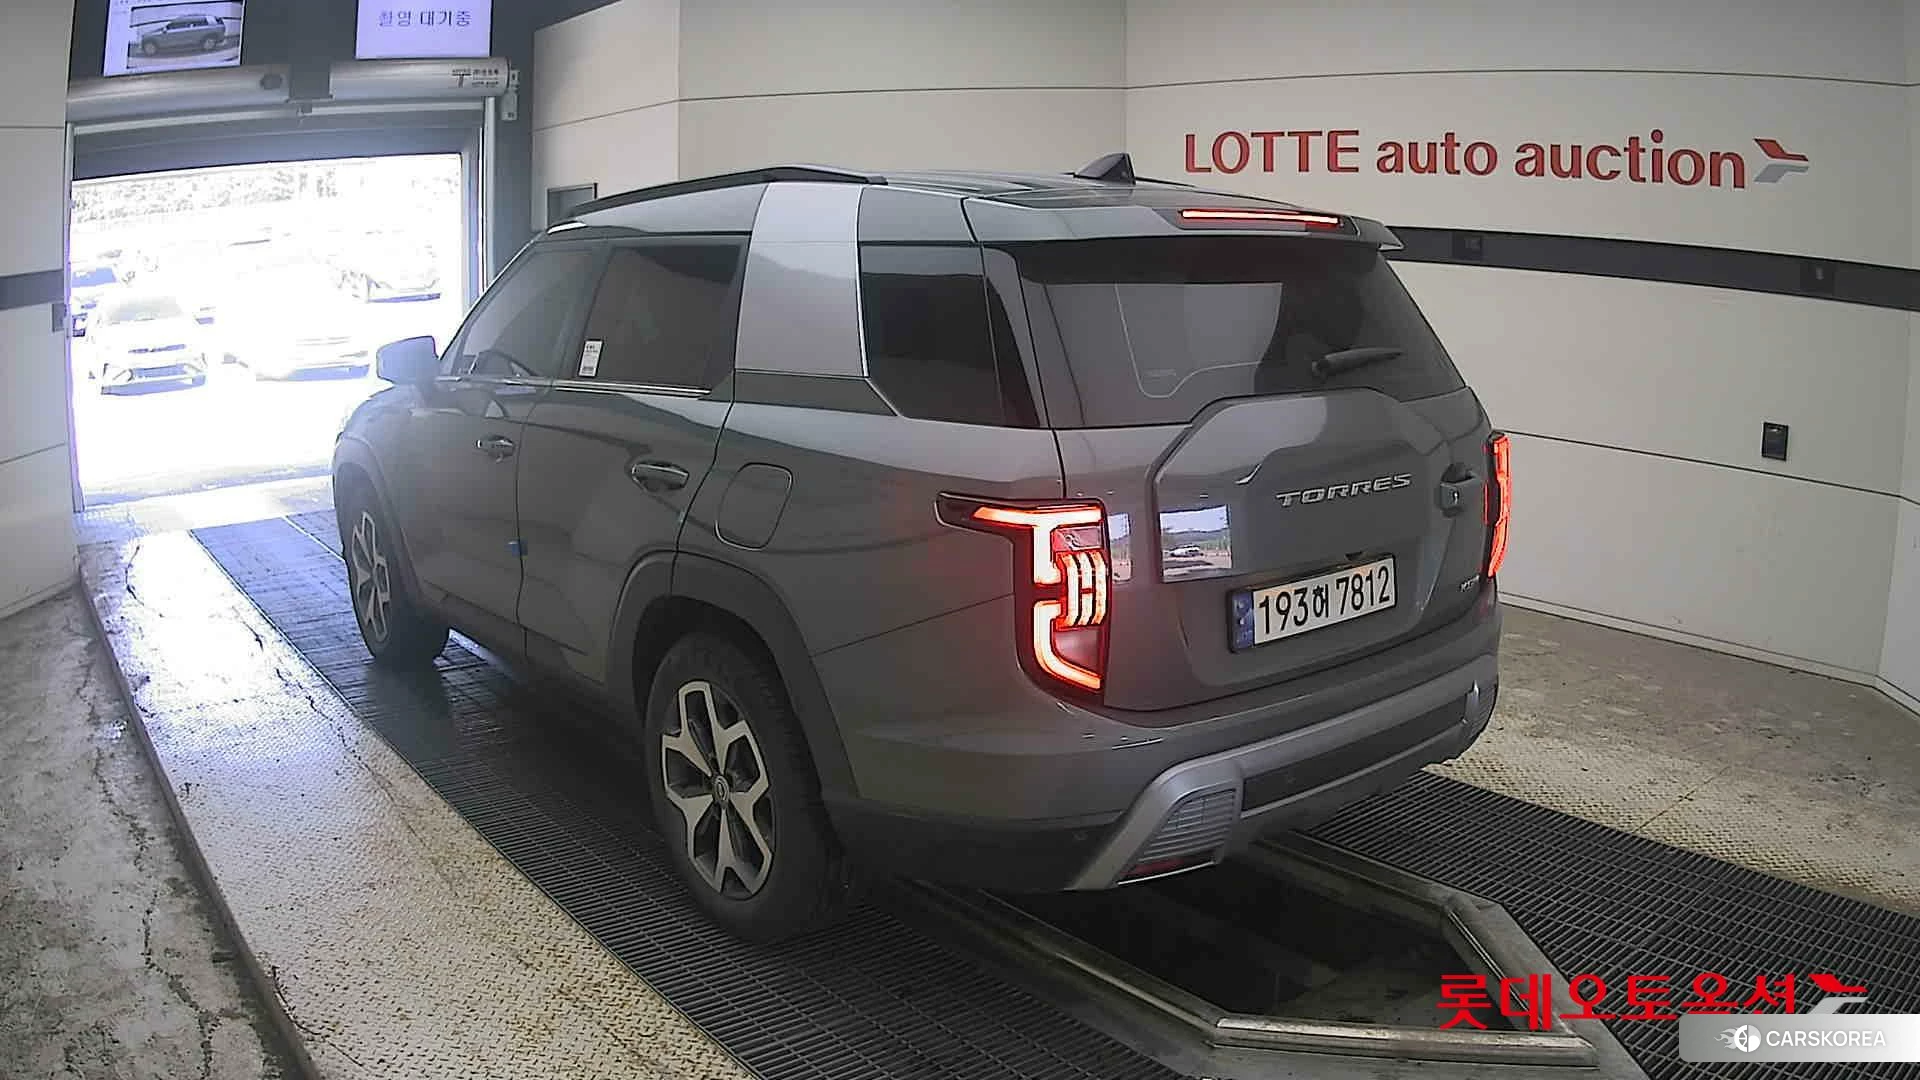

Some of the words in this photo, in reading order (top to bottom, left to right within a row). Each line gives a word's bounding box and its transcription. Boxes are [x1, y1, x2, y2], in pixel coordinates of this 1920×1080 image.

[420, 10, 472, 27] 대기중
[1185, 130, 1360, 174] LOTTE
[1377, 132, 1498, 177] auto
[1514, 130, 1745, 188] auction
[1276, 473, 1412, 507] TORRES
[1258, 583, 1330, 634] 193허
[1336, 566, 1390, 615] 7812
